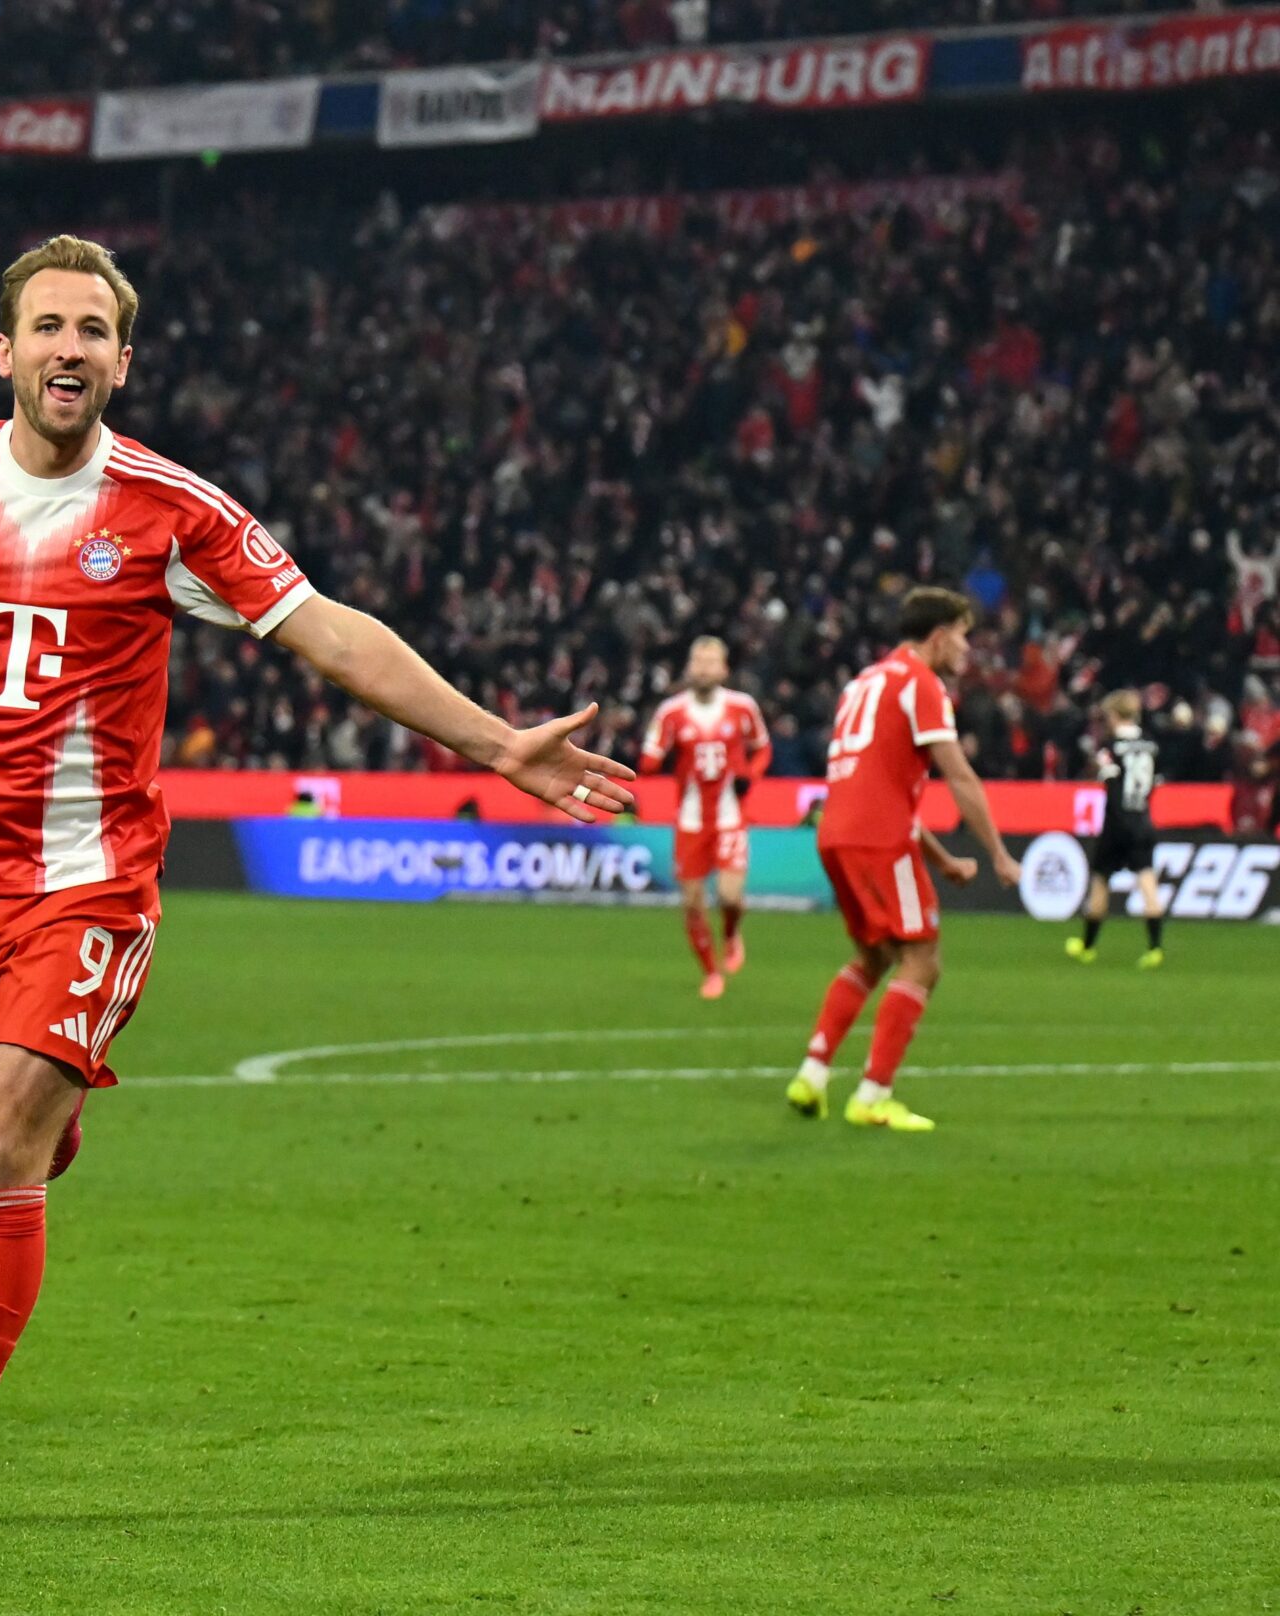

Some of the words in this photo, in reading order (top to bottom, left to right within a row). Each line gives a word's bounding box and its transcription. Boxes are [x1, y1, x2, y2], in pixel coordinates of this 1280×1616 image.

[93, 542, 118, 560] BAYERN
[298, 837, 653, 892] EASPORTS.COM/FC
[1108, 842, 1280, 918] C26
[68, 926, 115, 997] 9
